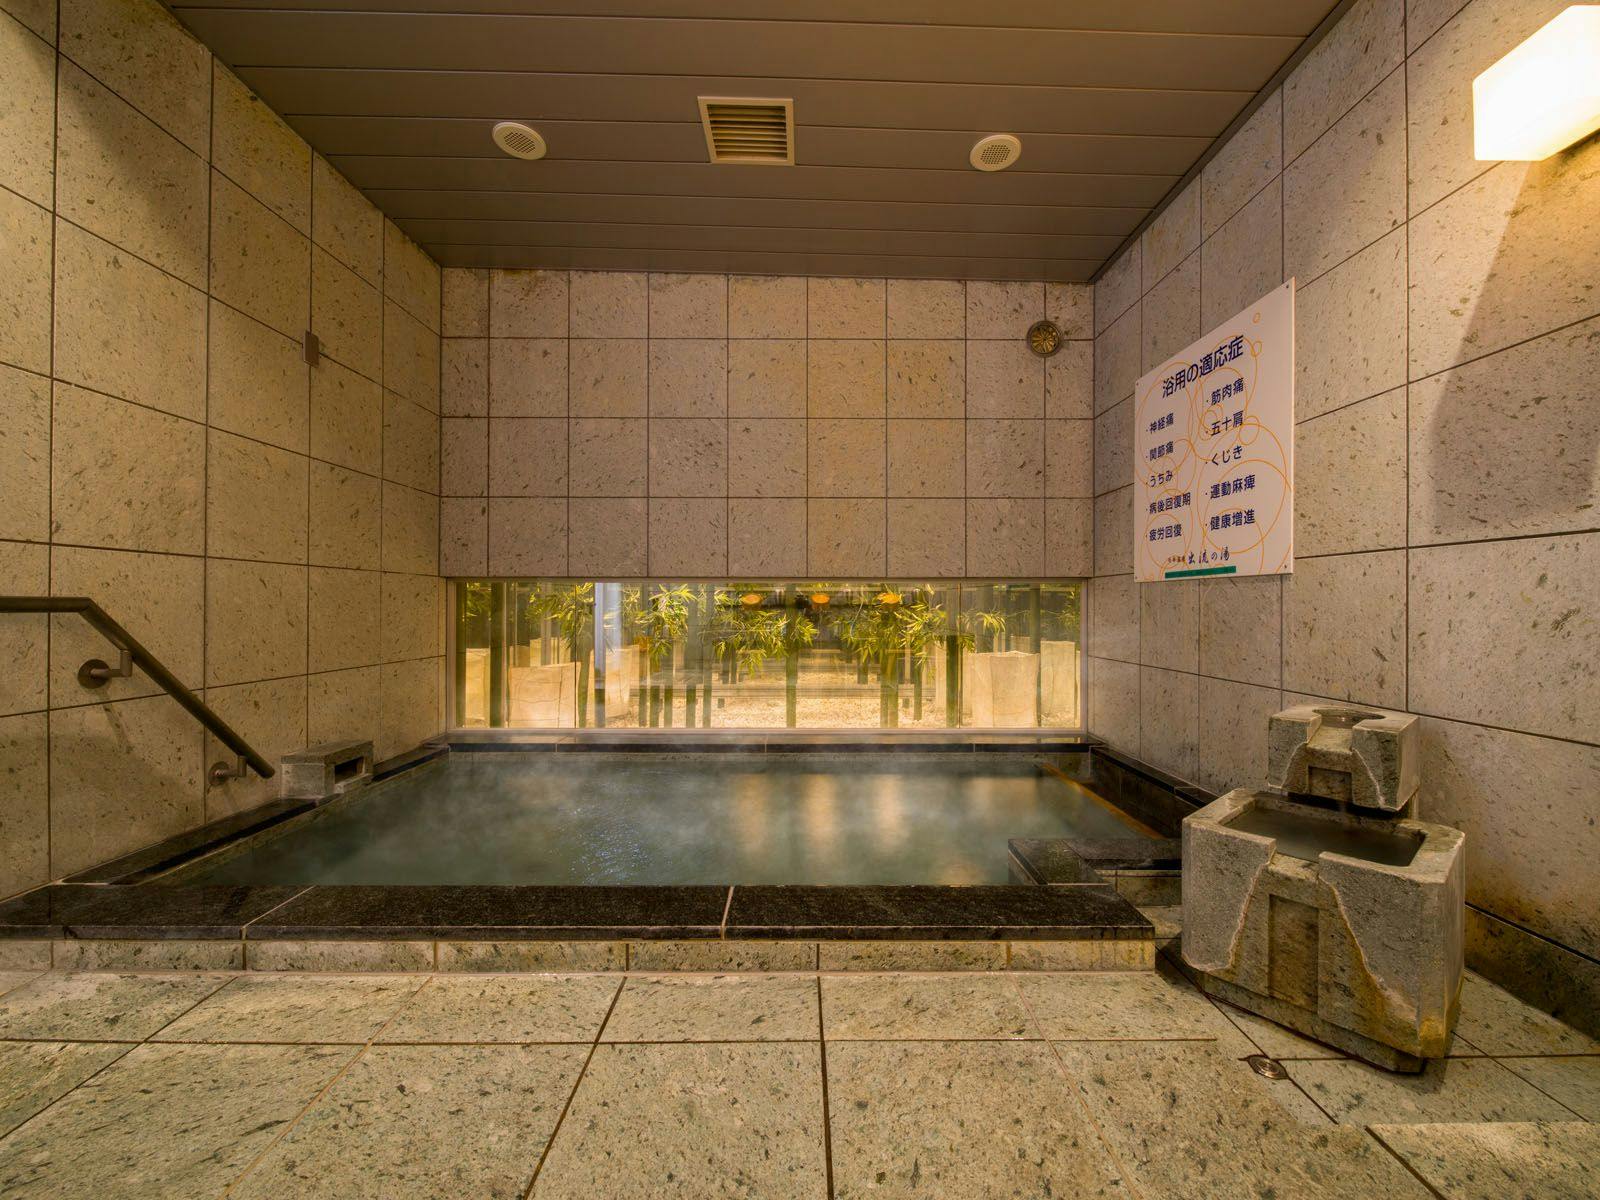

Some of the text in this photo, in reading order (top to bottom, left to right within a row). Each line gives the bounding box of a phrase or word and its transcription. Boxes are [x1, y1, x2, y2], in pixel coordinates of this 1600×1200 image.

[1162, 335, 1244, 398] 浴用の適応症
[1211, 377, 1244, 406] 筋肉痛
[1211, 410, 1244, 437] 五十肩
[1211, 445, 1243, 466] くじき
[1150, 470, 1173, 488] うちみ
[1210, 509, 1255, 531] 健康増進
